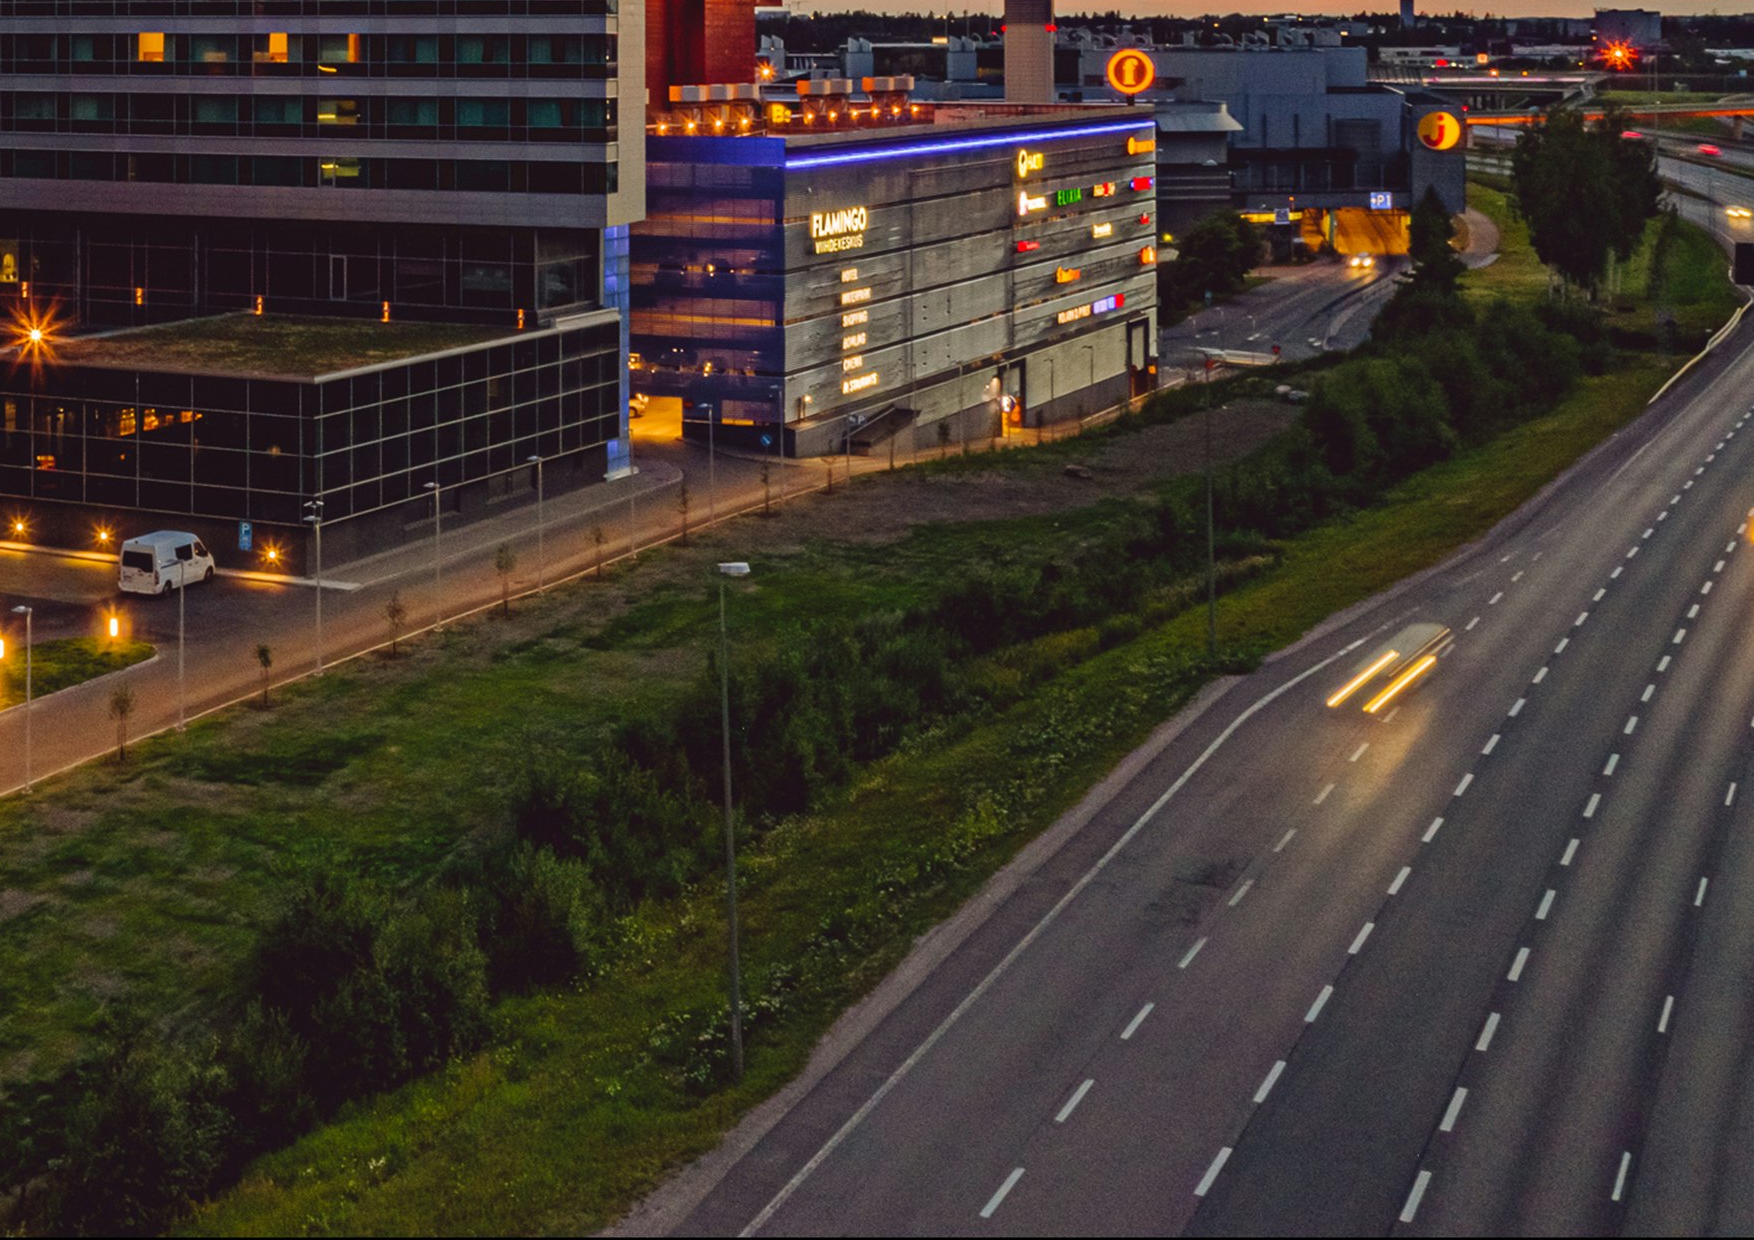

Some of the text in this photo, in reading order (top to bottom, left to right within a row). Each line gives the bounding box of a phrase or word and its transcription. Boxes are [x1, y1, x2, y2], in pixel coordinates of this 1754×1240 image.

[1377, 194, 1392, 207] P1
[812, 206, 867, 238] FLAMINGO
[241, 522, 251, 535] P
